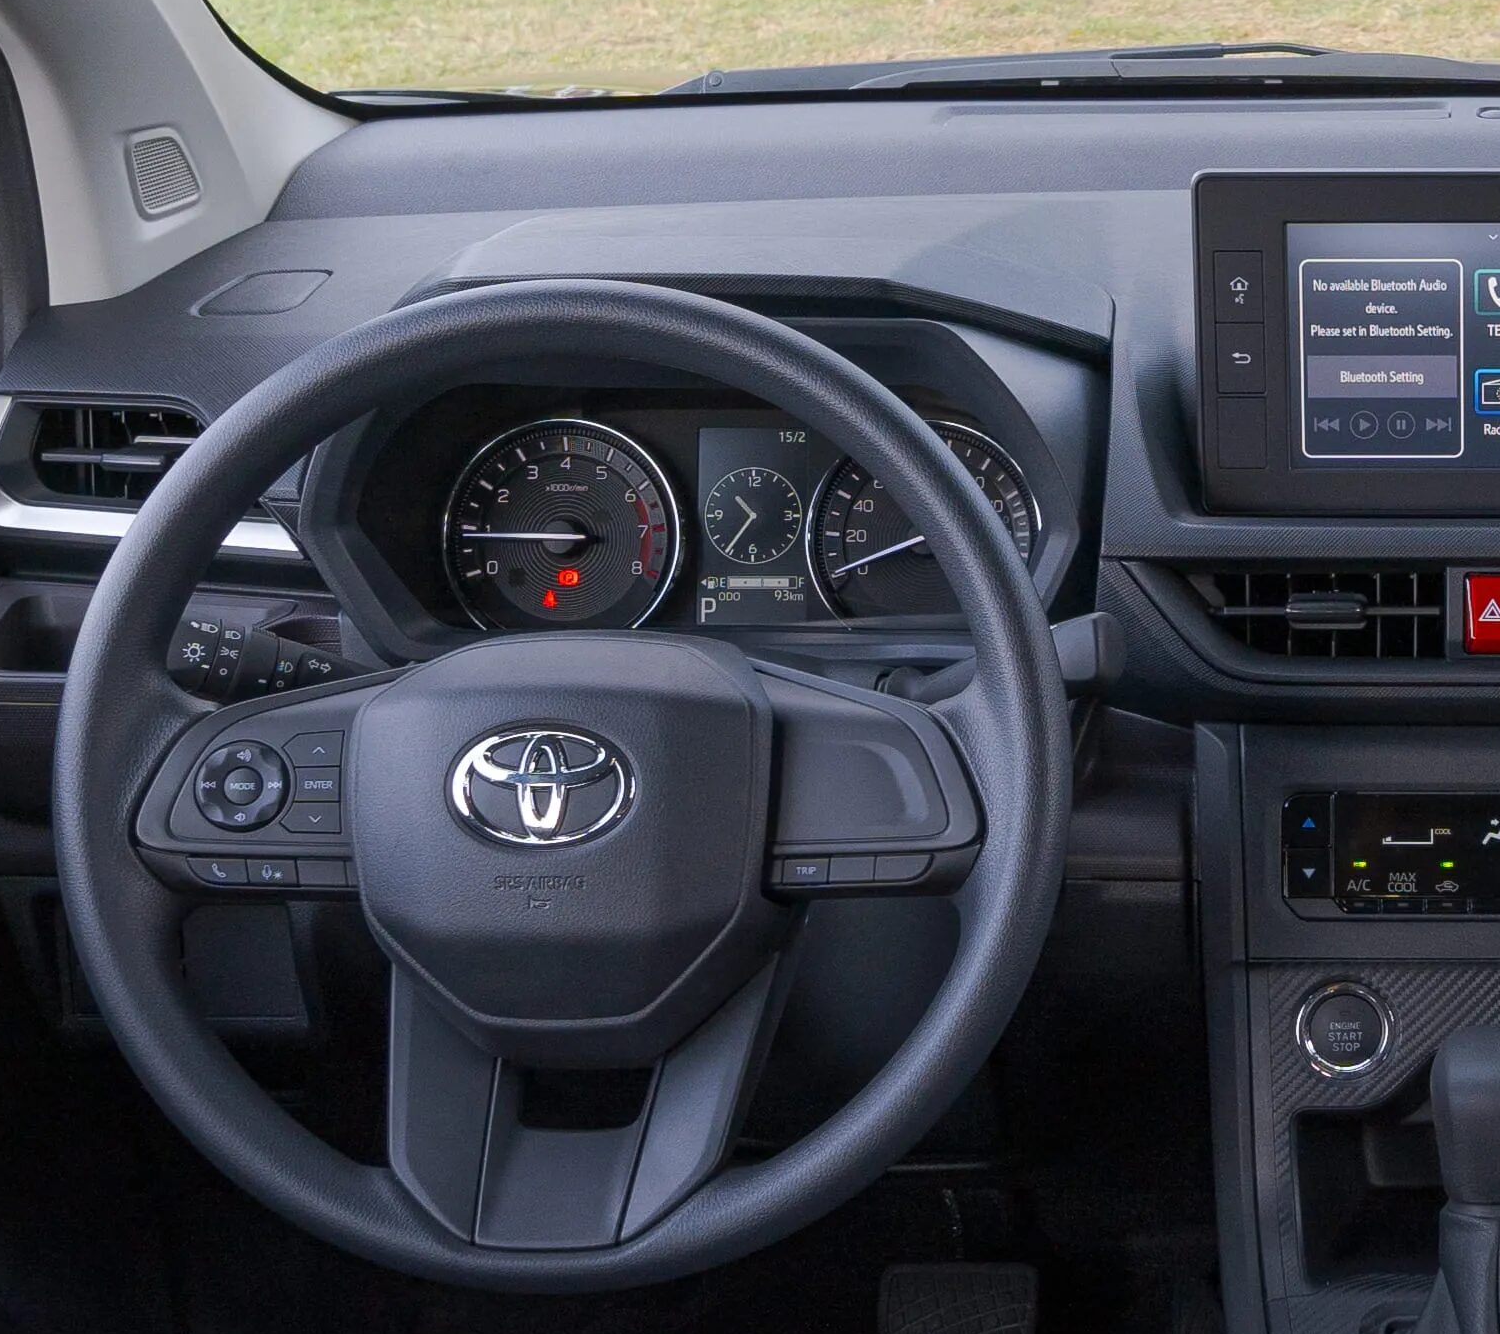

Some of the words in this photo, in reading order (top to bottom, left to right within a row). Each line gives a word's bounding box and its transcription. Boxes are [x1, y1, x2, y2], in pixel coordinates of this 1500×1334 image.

[1313, 279, 1327, 291] No
[1329, 279, 1369, 291] available
[1371, 279, 1417, 291] Bluetooth
[1419, 279, 1447, 291] Audio
[1365, 302, 1398, 314] device.
[1310, 324, 1340, 337] Please
[1342, 326, 1356, 337] set
[1358, 325, 1367, 337] in
[1369, 324, 1415, 337] Bluetooth
[1417, 324, 1453, 339] Setting.
[1340, 371, 1387, 383] Bluetooth
[1389, 371, 1424, 385] Setting
[778, 431, 807, 444] 15/2
[560, 456, 572, 470] 4
[527, 465, 539, 480] 3
[595, 465, 608, 480] 5
[748, 476, 762, 487] 12
[497, 489, 510, 503] 2
[624, 488, 636, 503] 6
[853, 499, 874, 513] 40
[714, 509, 724, 521] 9
[783, 510, 793, 521] 3
[637, 524, 649, 539] 7
[845, 529, 867, 543] 20
[748, 543, 757, 554] 6
[486, 560, 498, 575] 0
[631, 560, 643, 575] 8
[719, 577, 726, 588] E
[798, 577, 805, 588] F
[718, 591, 741, 602] ODO
[700, 597, 717, 623] P
[230, 782, 257, 791] MODE
[304, 780, 333, 790] ENTER
[1434, 828, 1452, 836] COOL
[796, 866, 817, 875] TRIP
[494, 874, 524, 891] SRS
[526, 874, 587, 891] AIRBAG
[1389, 872, 1417, 882] MAX
[1347, 878, 1372, 893] A/C
[1387, 882, 1418, 893] COOL
[1329, 1021, 1362, 1030] ENGINE
[1327, 1031, 1363, 1042] START
[1332, 1042, 1361, 1052] STOP
